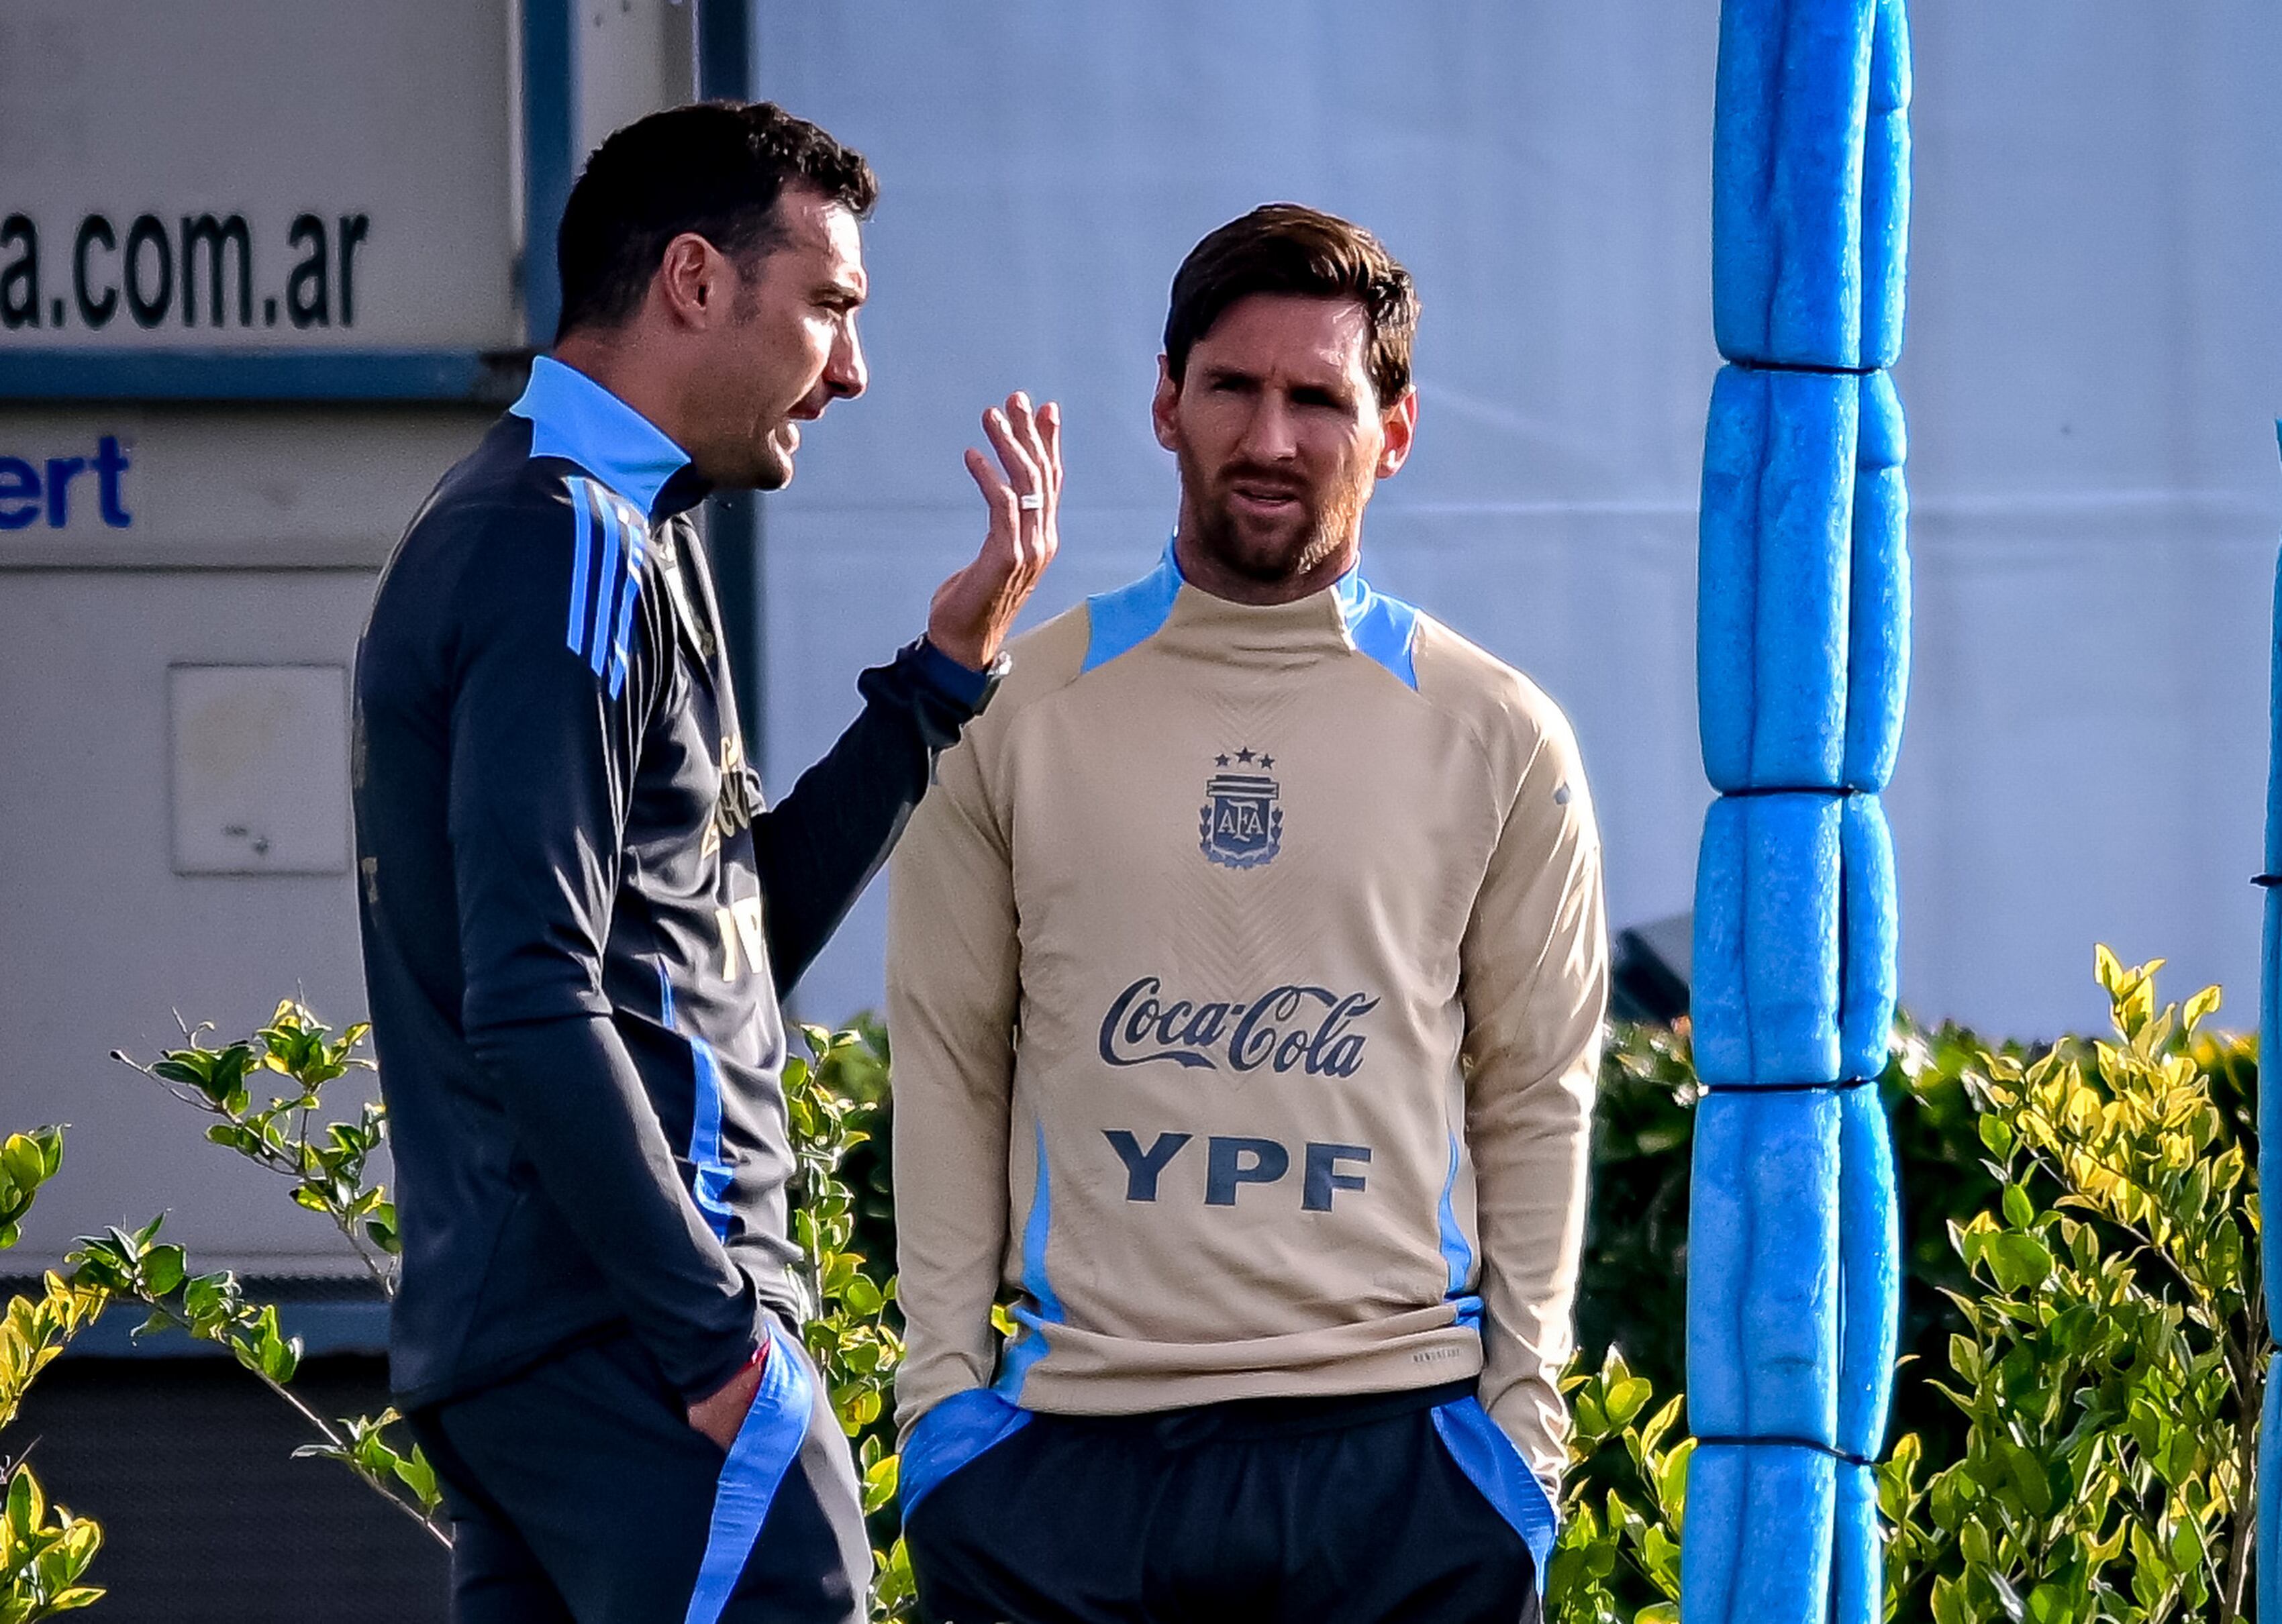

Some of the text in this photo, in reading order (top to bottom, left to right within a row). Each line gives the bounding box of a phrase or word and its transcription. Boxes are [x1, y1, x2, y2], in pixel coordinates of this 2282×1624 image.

[0, 213, 370, 330] a.com.ar
[0, 435, 131, 530] ert
[1218, 798, 1264, 842] AFA
[1099, 976, 1380, 1078] Coca-Cola
[1101, 1129, 1372, 1213] YPF
